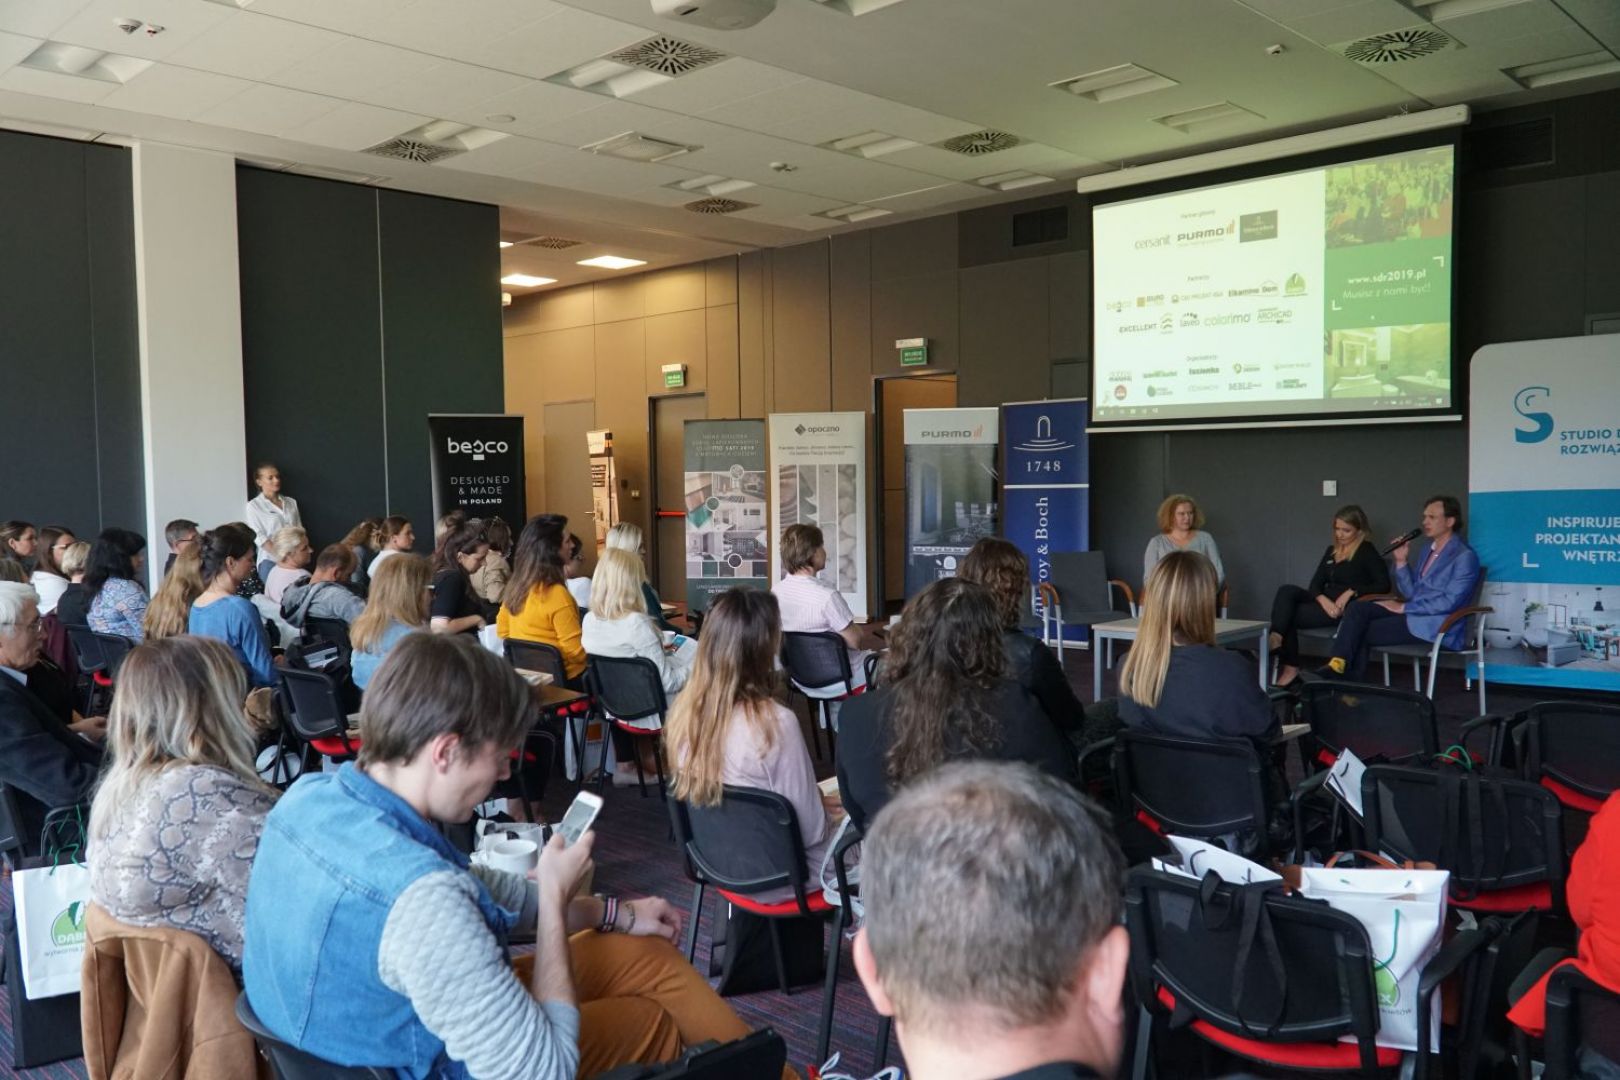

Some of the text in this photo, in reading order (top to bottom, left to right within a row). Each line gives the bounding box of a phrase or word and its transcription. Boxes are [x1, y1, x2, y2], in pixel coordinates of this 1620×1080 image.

[1177, 227, 1224, 241] PURMO
[1134, 235, 1171, 250] cersanit
[1348, 269, 1426, 284] www.sdr2019.pl
[1204, 314, 1251, 327] colorimo
[1119, 323, 1157, 333] EXCELLENT
[808, 425, 840, 434] opoczno
[1560, 429, 1612, 441] STUDIO
[447, 437, 509, 454] besco
[1026, 460, 1061, 473] 1748
[450, 475, 510, 485] DESIGNED
[458, 486, 503, 495] & MADE
[1035, 496, 1049, 540] Boch
[1037, 544, 1049, 555] &
